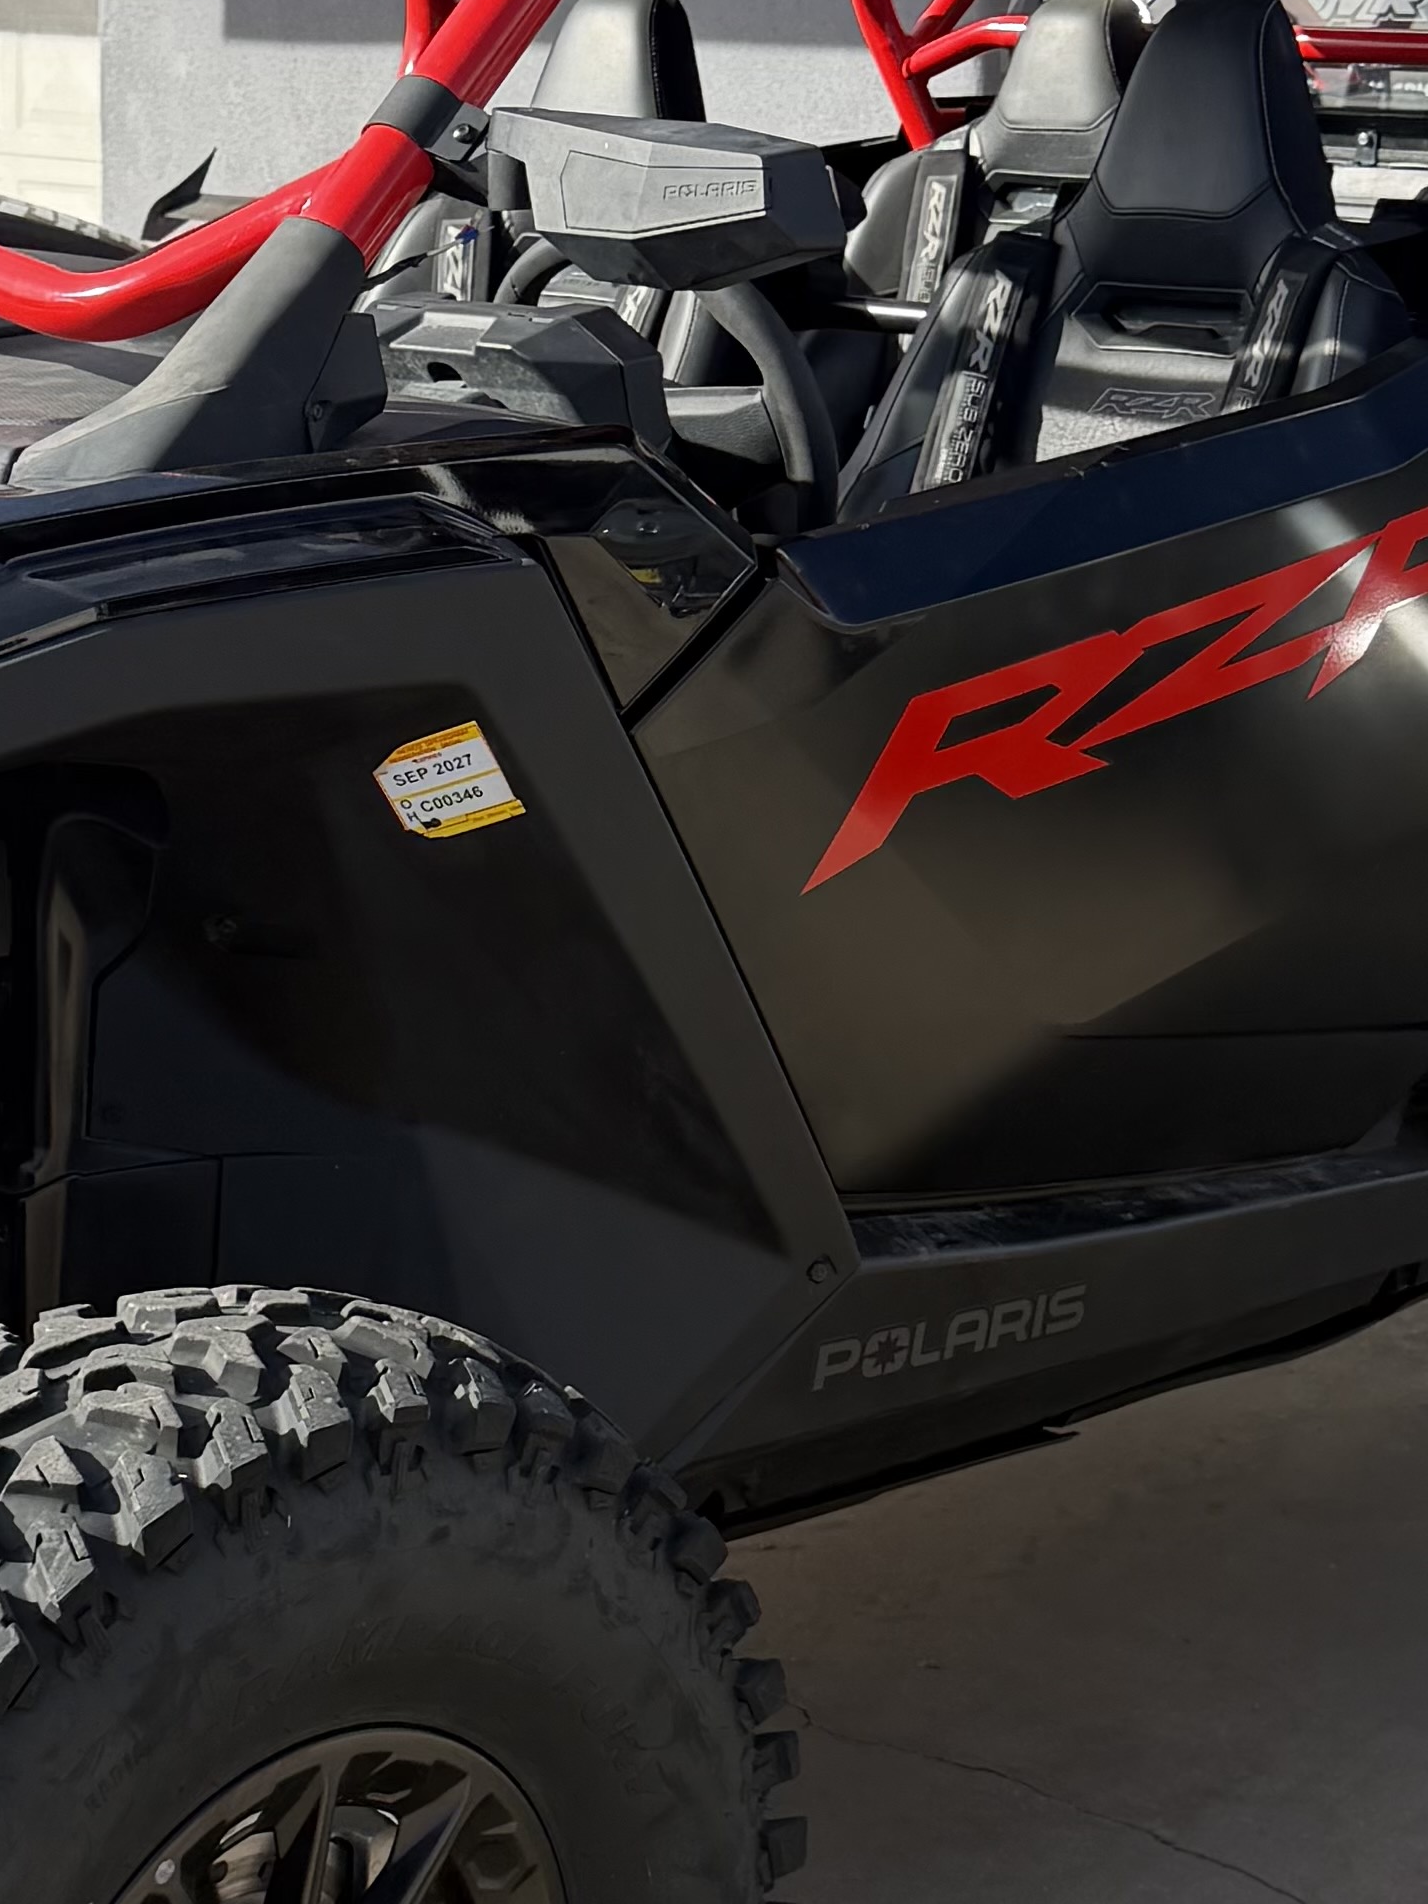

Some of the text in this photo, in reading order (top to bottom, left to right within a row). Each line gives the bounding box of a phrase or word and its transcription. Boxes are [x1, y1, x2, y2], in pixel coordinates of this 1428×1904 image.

[662, 178, 758, 201] POLARIS
[919, 181, 947, 259] RZR
[968, 268, 1014, 374] RZR
[1087, 386, 1217, 420] RZR
[947, 426, 976, 484] ZERO
[392, 753, 472, 787] SEP 2027
[420, 786, 484, 813] C00346
[811, 1284, 1087, 1392] POLARIS
